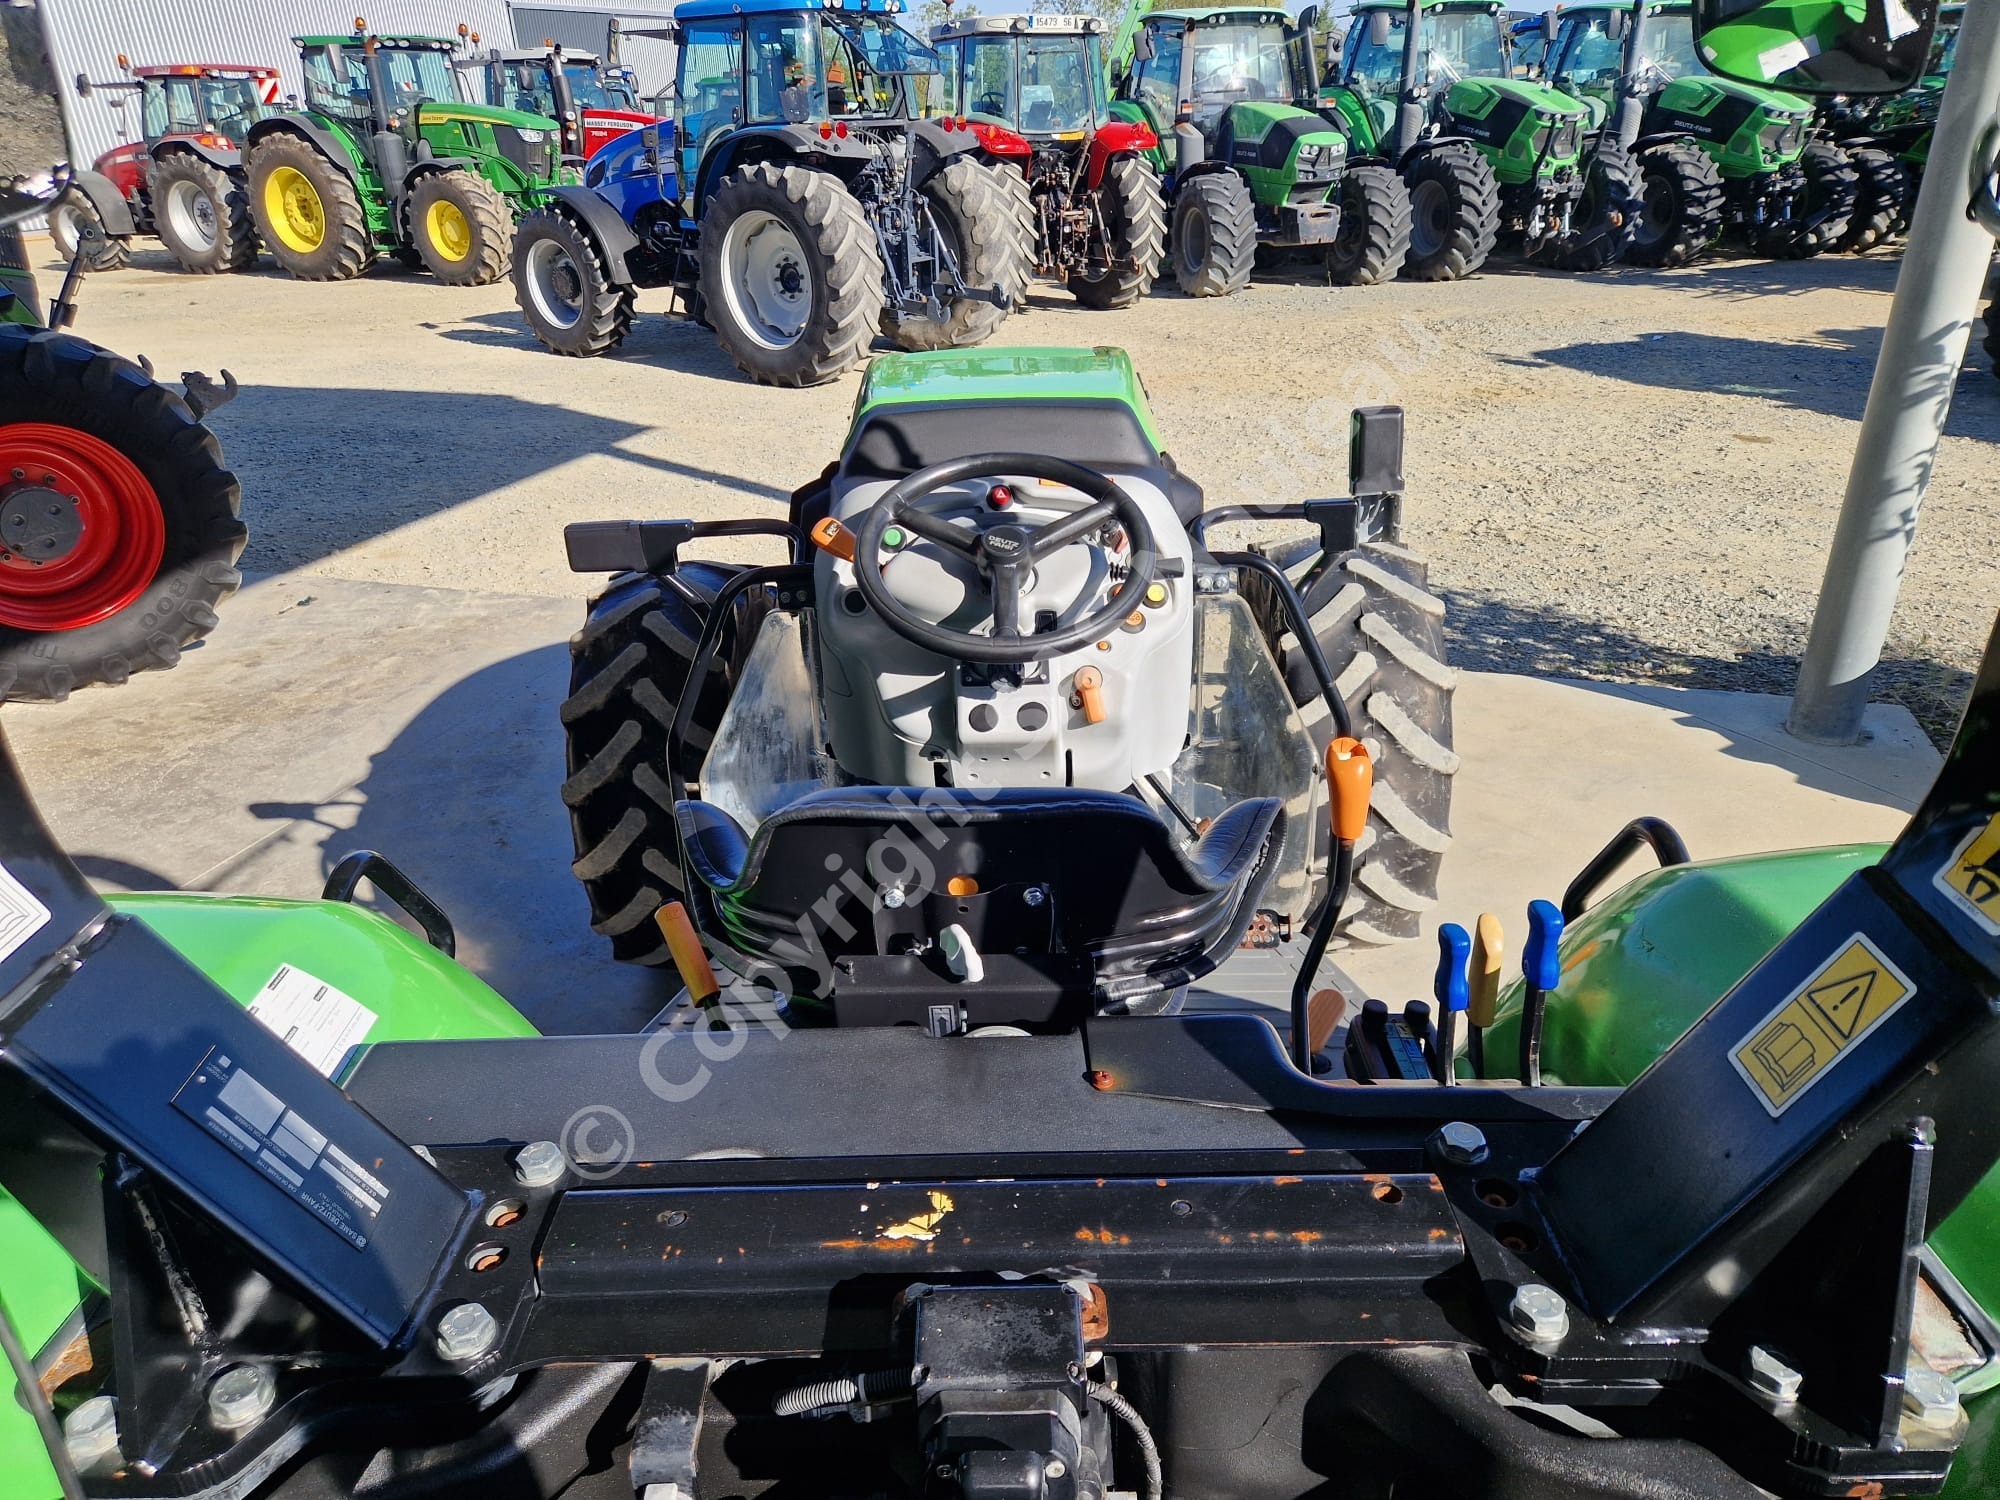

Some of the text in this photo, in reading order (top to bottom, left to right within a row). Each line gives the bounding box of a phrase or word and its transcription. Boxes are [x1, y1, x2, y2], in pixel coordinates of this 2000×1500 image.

[1036, 17, 1057, 26] 15473
[1063, 18, 1072, 26] 56
[607, 121, 634, 129] FERGUSON
[1673, 120, 1712, 133] DEUTZ-FAHR
[988, 535, 1020, 548] DEUTZ
[300, 1191, 340, 1225] DEUTZ-FAHR
[338, 1221, 358, 1239] SAME
